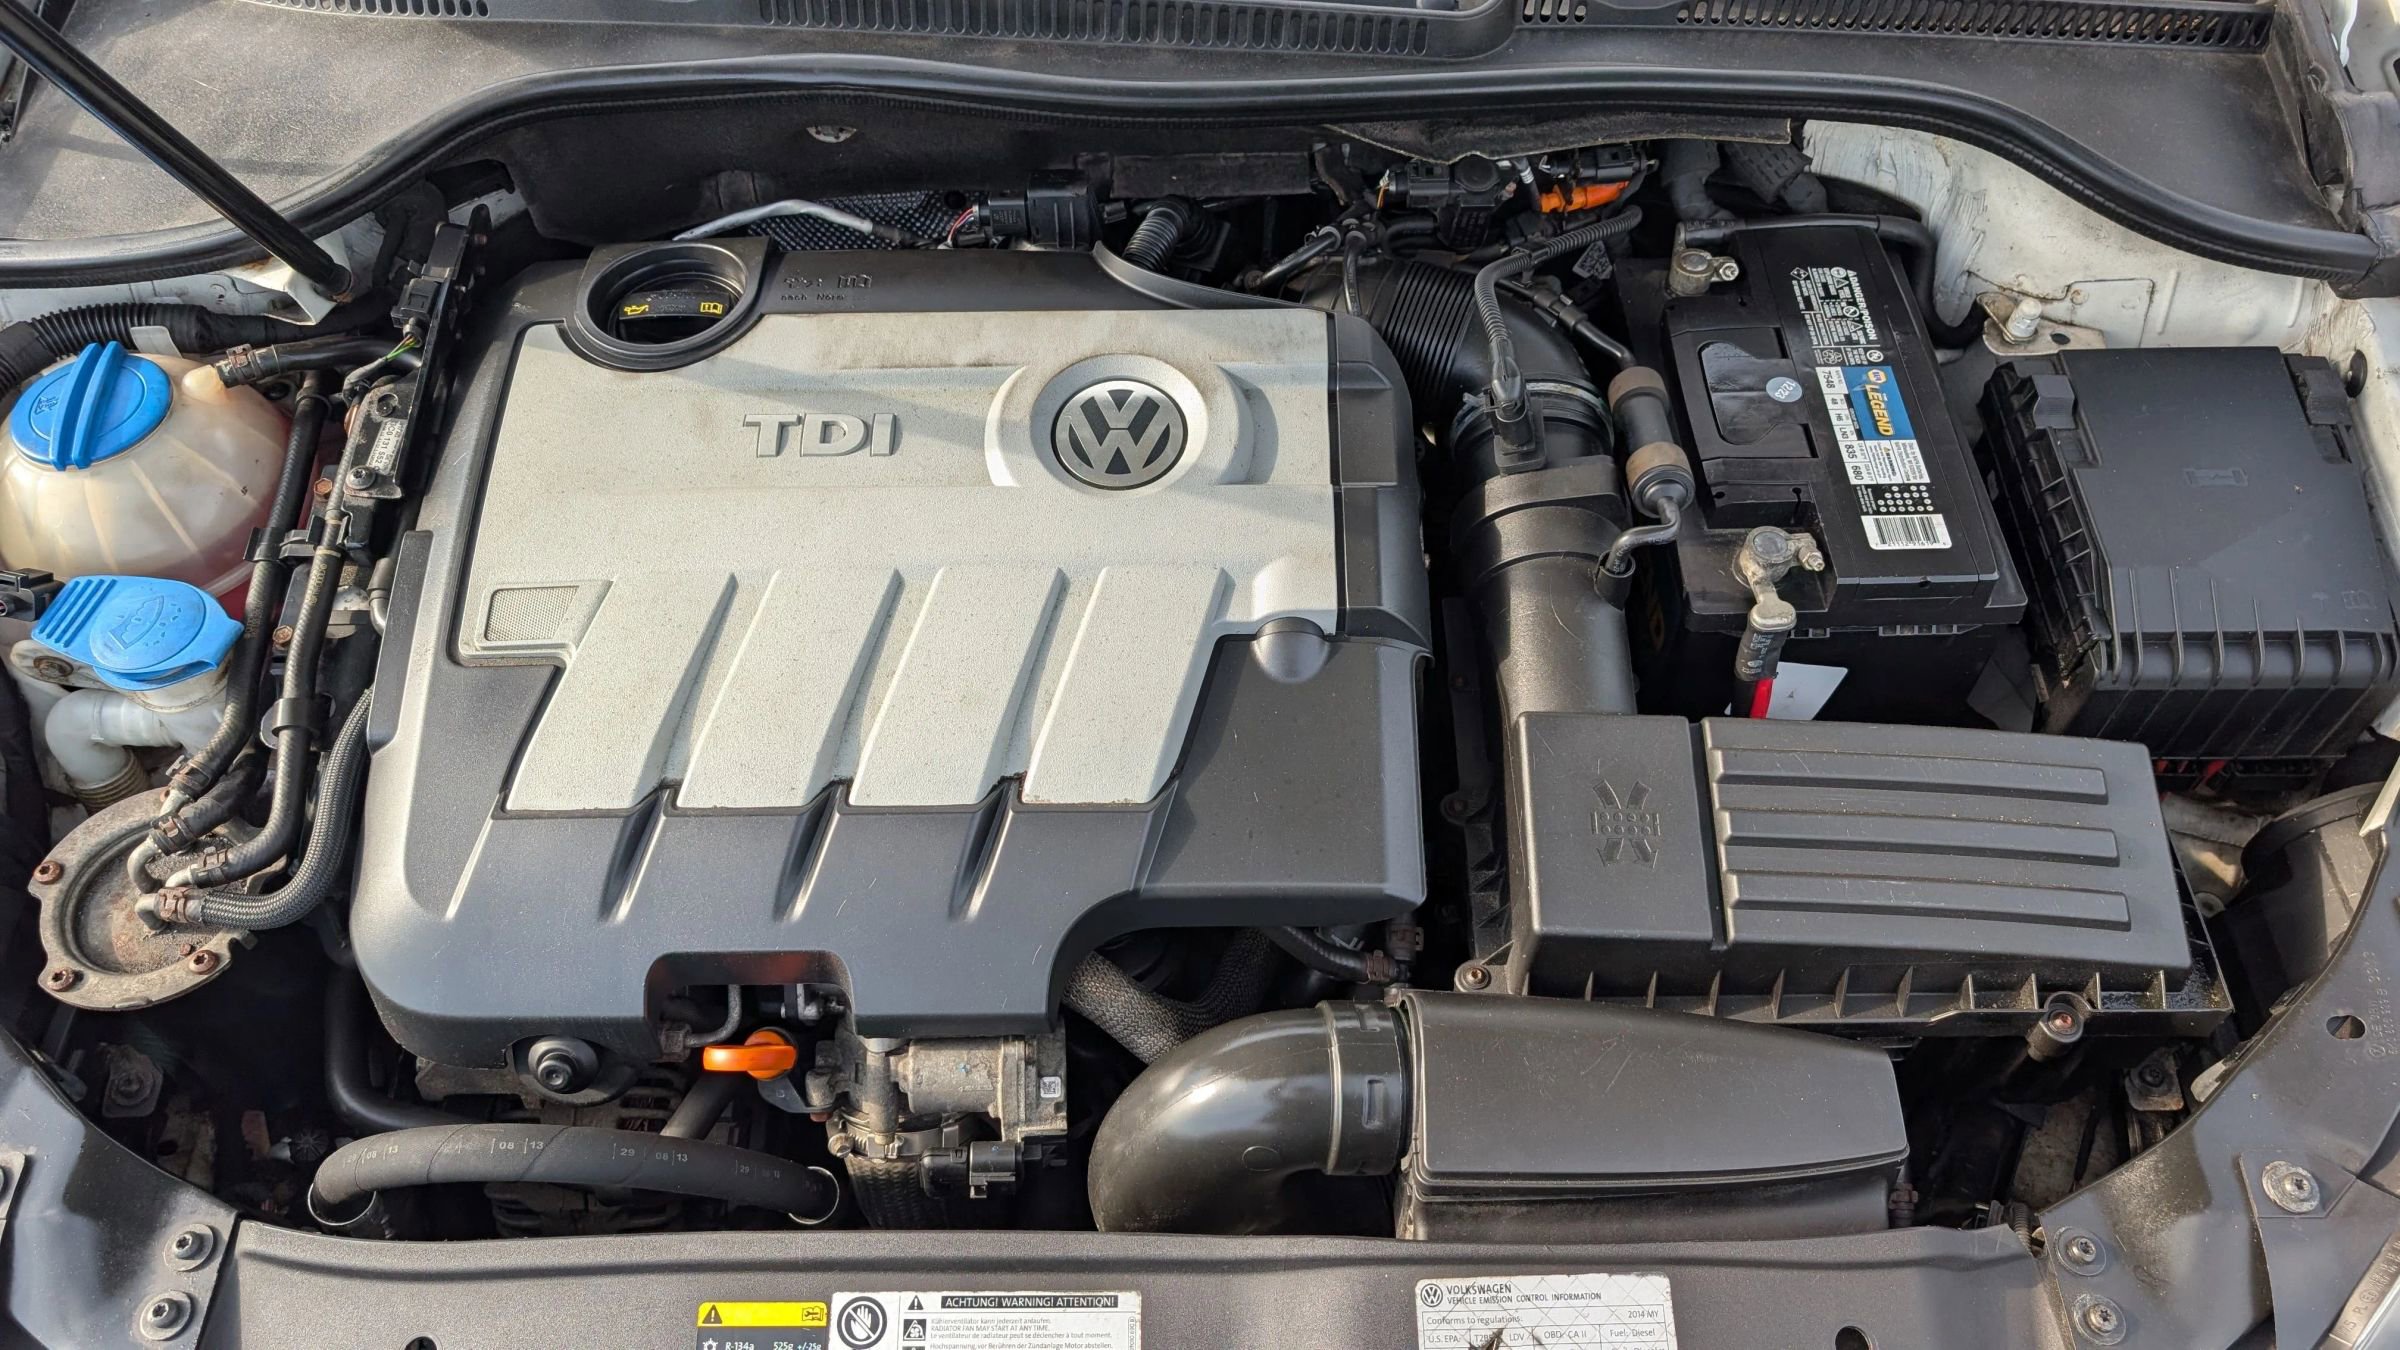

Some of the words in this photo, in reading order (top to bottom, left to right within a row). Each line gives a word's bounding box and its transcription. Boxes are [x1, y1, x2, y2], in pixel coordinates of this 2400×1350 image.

[1848, 276, 1878, 341] DANGER/POISON
[1821, 370, 1836, 388] 7548
[1775, 378, 1798, 400] 12/23
[1829, 397, 1838, 405] 48
[1867, 384, 1895, 437] LEGEND
[1834, 412, 1843, 421] H6
[743, 413, 897, 458] TDI
[1838, 426, 1849, 439] LN3
[381, 437, 391, 449] 131
[1843, 443, 1857, 459] 835
[1850, 464, 1864, 481] 680
[388, 1145, 398, 1154] 13
[499, 1142, 515, 1150] 08
[530, 1141, 544, 1150] 13
[620, 1148, 636, 1157] 29
[655, 1151, 669, 1161] 08
[676, 1153, 688, 1162] 13
[739, 1165, 750, 1173] 29
[1446, 1284, 1512, 1295] VOLKSWAGEN
[945, 1297, 999, 1307] ACHTUNG!
[1000, 1296, 1054, 1307] WARNING!
[1056, 1296, 1115, 1307] ATTENTION!
[1447, 1296, 1477, 1305] VEHICLE
[1479, 1295, 1513, 1304] EMISSION
[1516, 1294, 1548, 1303] CONTROL
[1551, 1292, 1602, 1301] INFORMATION
[1628, 1310, 1645, 1319] 2014
[1647, 1310, 1659, 1318] MY
[996, 1318, 1023, 1326] jederzeit
[1426, 1317, 1465, 1325] Conforms
[1467, 1316, 1476, 1324] to
[1009, 1332, 1024, 1340] peut
[1509, 1333, 1525, 1341] LDV
[1632, 1328, 1656, 1337] Diesel
[1428, 1335, 1443, 1343] U.S.
[725, 1342, 755, 1350] R-134a
[1016, 1342, 1027, 1350] der
[1064, 1342, 1083, 1350] Motor
